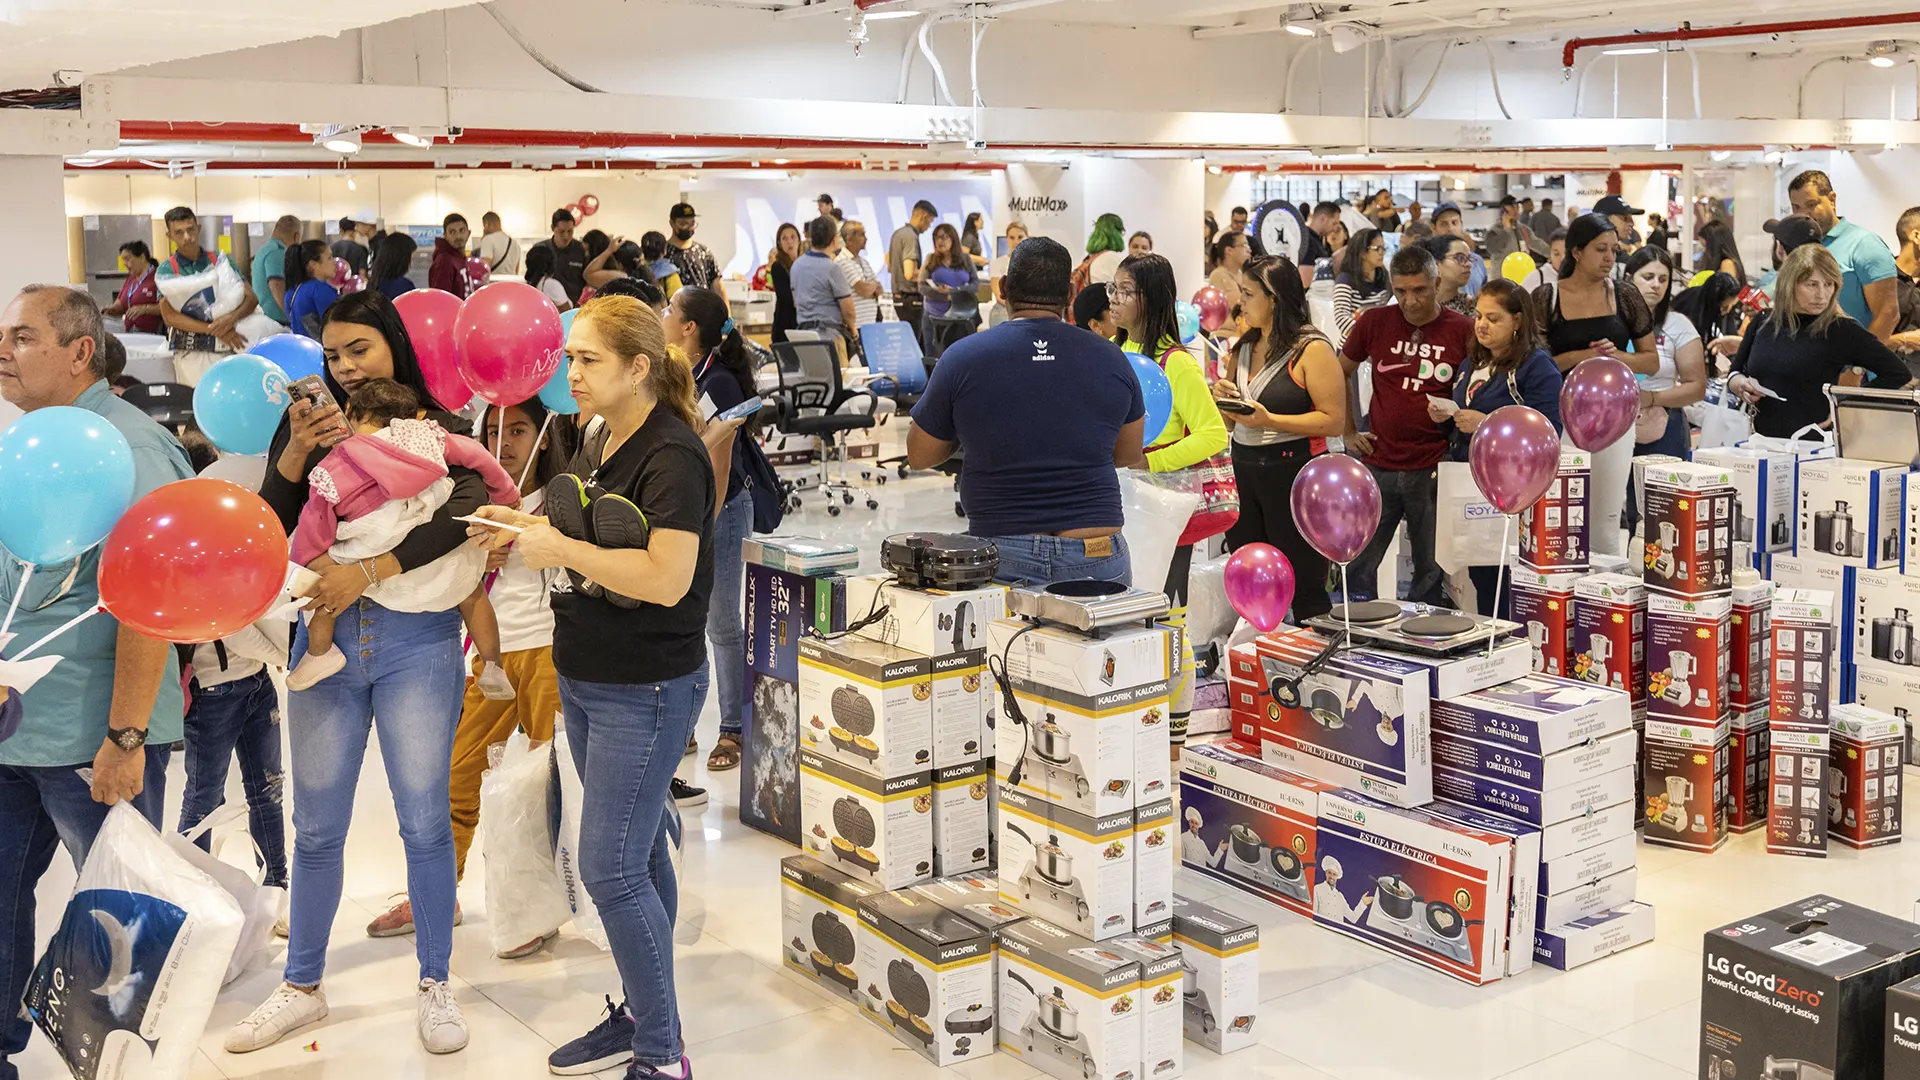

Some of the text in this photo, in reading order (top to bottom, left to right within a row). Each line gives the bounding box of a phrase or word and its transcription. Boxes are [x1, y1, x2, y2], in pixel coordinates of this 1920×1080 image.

[1009, 196, 1062, 211] MultiMax
[1032, 353, 1055, 361] adidas
[1390, 340, 1445, 359] JUST
[1418, 359, 1453, 383] DO
[1402, 377, 1424, 391] IT
[1733, 462, 1756, 470] JUICER
[1816, 567, 1840, 576] JUICER
[1904, 581, 1920, 589] JUIC
[748, 576, 756, 651] CYBERLUX
[771, 598, 777, 615] HD
[770, 616, 777, 631] TV
[769, 631, 777, 668] SMART
[1172, 630, 1180, 673] KALORIK
[936, 656, 968, 669] KALORIK
[885, 664, 918, 678] KALORIK
[1135, 682, 1167, 697] KALORIK
[1903, 681, 1920, 690] JUIC
[1098, 691, 1132, 705] KALORIK
[1510, 728, 1529, 744] ESTUFA
[1185, 756, 1208, 768] UNIVERSAL
[1334, 754, 1365, 770] ESTUFA
[943, 765, 975, 779] KALORIK
[1512, 764, 1531, 779] ESTUFA
[886, 777, 919, 791] KALORIK
[1000, 791, 1028, 806] KALORIK
[1212, 784, 1277, 814] ESTUFA ELÉCTRICA
[1510, 798, 1529, 813] ESTUFA
[1139, 804, 1172, 819] KALORIK
[1325, 801, 1354, 814] UNIVERSAL
[1336, 811, 1353, 820] ROYAL
[1097, 816, 1132, 831] KALORIK
[1359, 832, 1438, 865] ESTUFA ELÉCTRICA
[1442, 842, 1472, 858] IU-E02SS
[561, 850, 577, 908] MultiMax
[1001, 936, 1031, 955] KALORIK
[1224, 930, 1258, 946] KALORIK
[941, 944, 978, 960] KALORIK
[1147, 957, 1181, 975] KALORIK
[1707, 953, 1730, 974] LG
[1104, 967, 1139, 986] KALORIK
[1707, 973, 1820, 1024] Powerful, Cordless, Long-Lasting
[1893, 1012, 1919, 1035] LG
